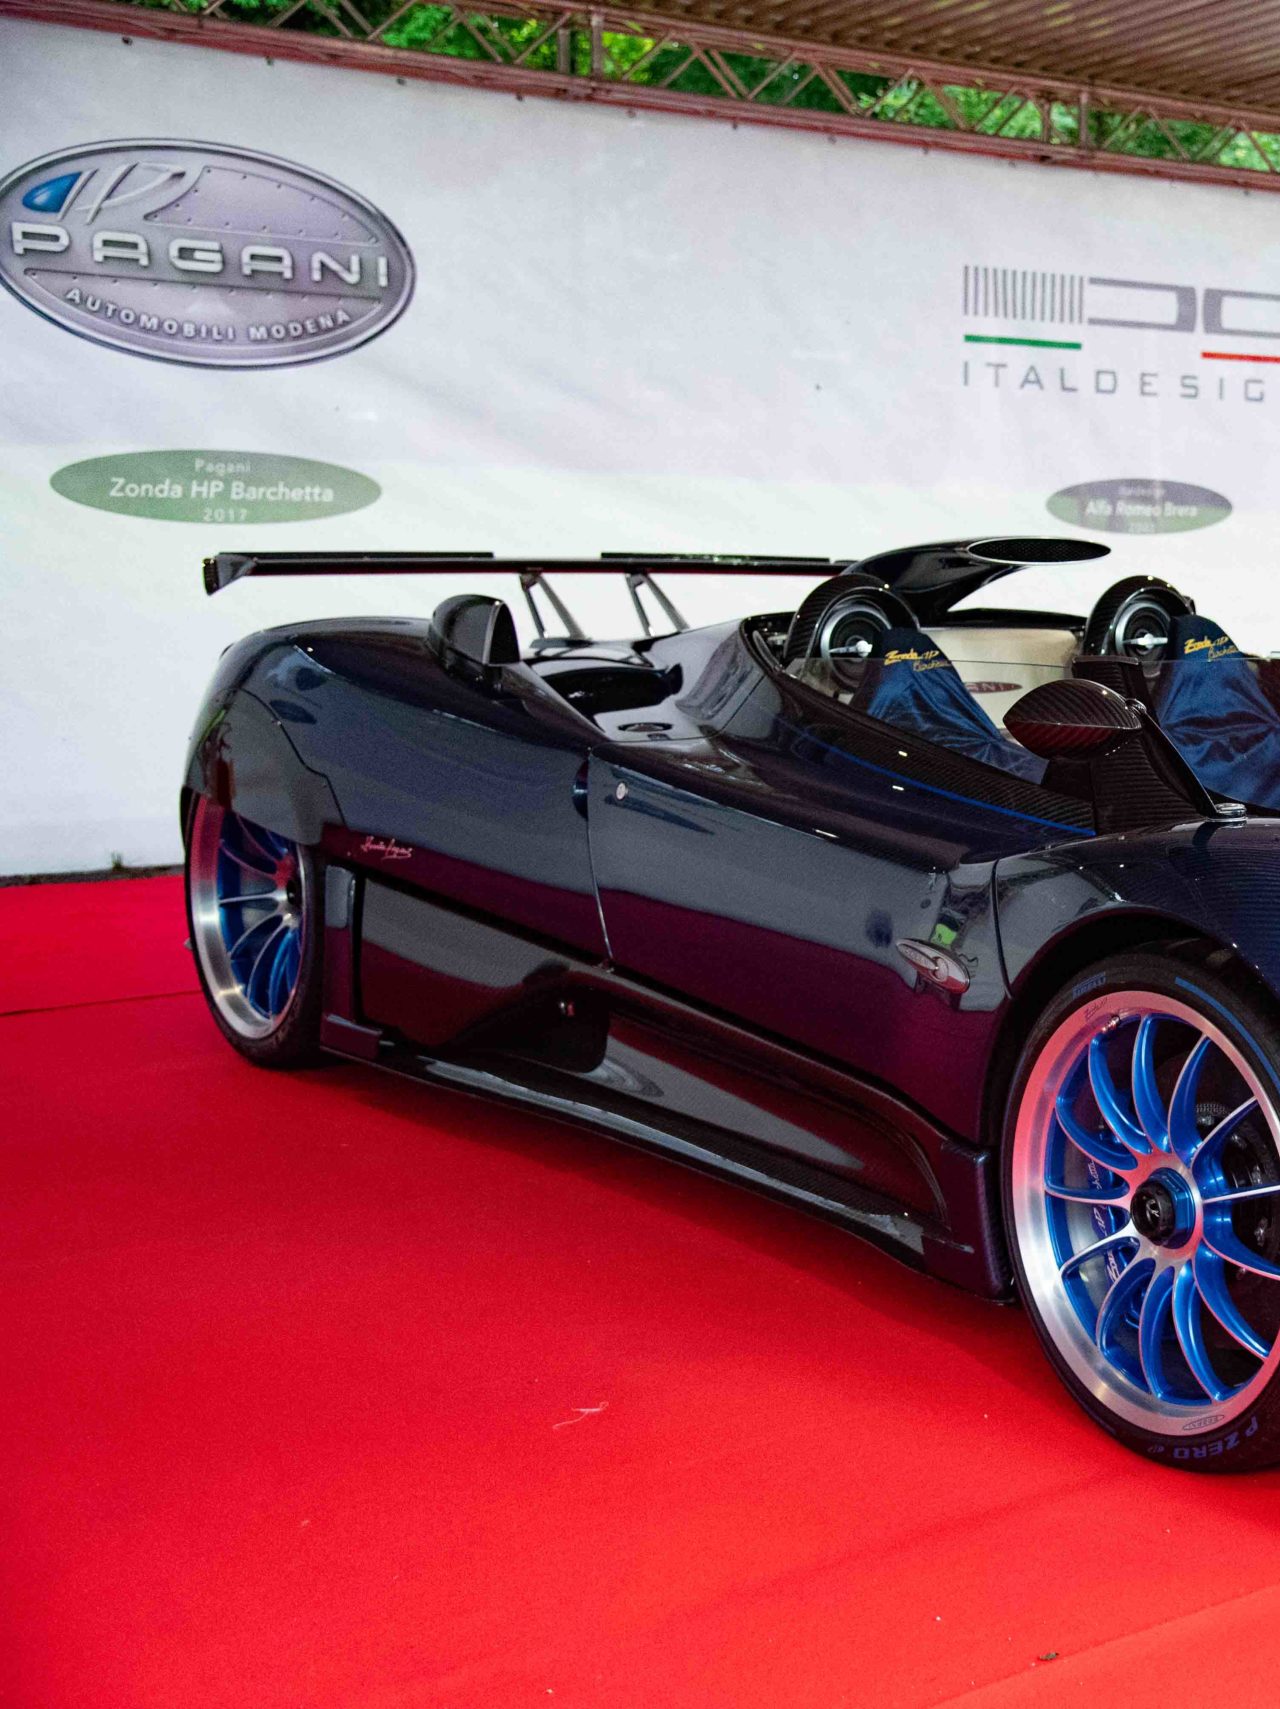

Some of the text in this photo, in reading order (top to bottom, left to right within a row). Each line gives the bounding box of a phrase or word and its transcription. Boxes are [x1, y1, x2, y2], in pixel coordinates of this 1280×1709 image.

[11, 221, 390, 288] PAGANI
[65, 286, 352, 341] AUTOMOBILI MODENA
[194, 457, 251, 476] Pagani
[109, 477, 334, 503] Zonda HP Barchetta
[202, 506, 249, 523] 2017
[1244, 1415, 1259, 1437] P
[1172, 1431, 1239, 1459] ZERO
